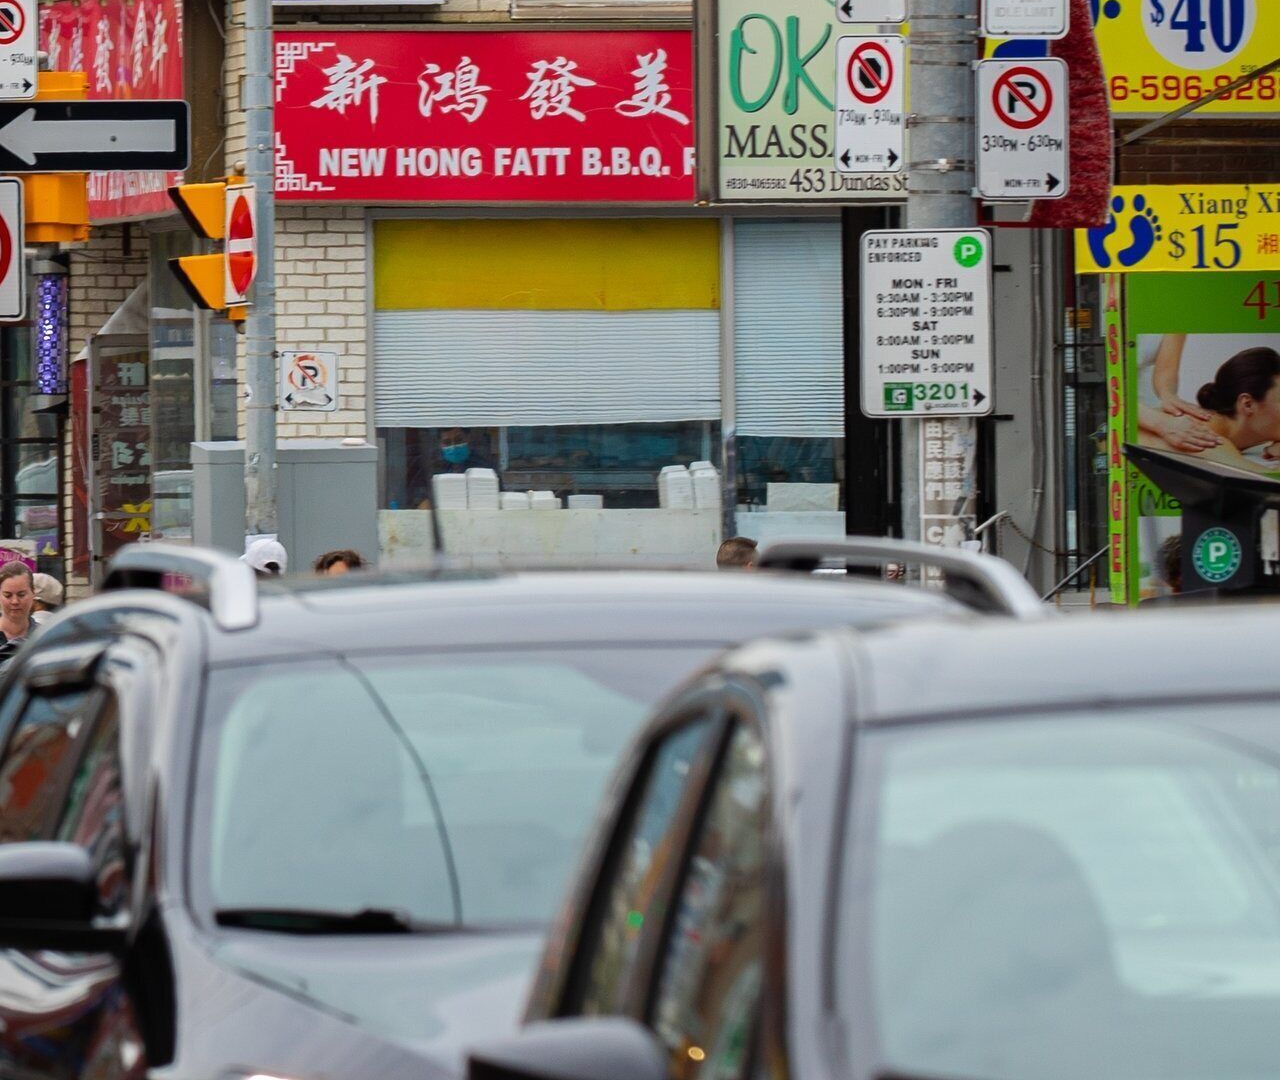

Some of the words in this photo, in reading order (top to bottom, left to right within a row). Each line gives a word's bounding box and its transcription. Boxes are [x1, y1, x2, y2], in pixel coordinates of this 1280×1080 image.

[729, 13, 836, 116] OK
[310, 49, 691, 125] 新鴻發美
[724, 124, 836, 159] MASS
[319, 148, 386, 176] NEW
[396, 148, 482, 176] HONG
[494, 147, 571, 176] FATT
[581, 147, 671, 177] B.B.Q.
[790, 168, 825, 193] 453
[830, 171, 890, 192] Dundas
[893, 172, 909, 191] St
[1179, 192, 1248, 219] Xiang
[867, 238, 888, 249] PAY
[1167, 223, 1242, 269] $15
[868, 252, 922, 263] ENFORCED
[892, 279, 924, 289] MON
[936, 278, 958, 288] FRI
[912, 321, 939, 331] SAT
[911, 349, 940, 359] SUN
[915, 384, 969, 401] 3201
[1104, 273, 1124, 574] ASSAGE
